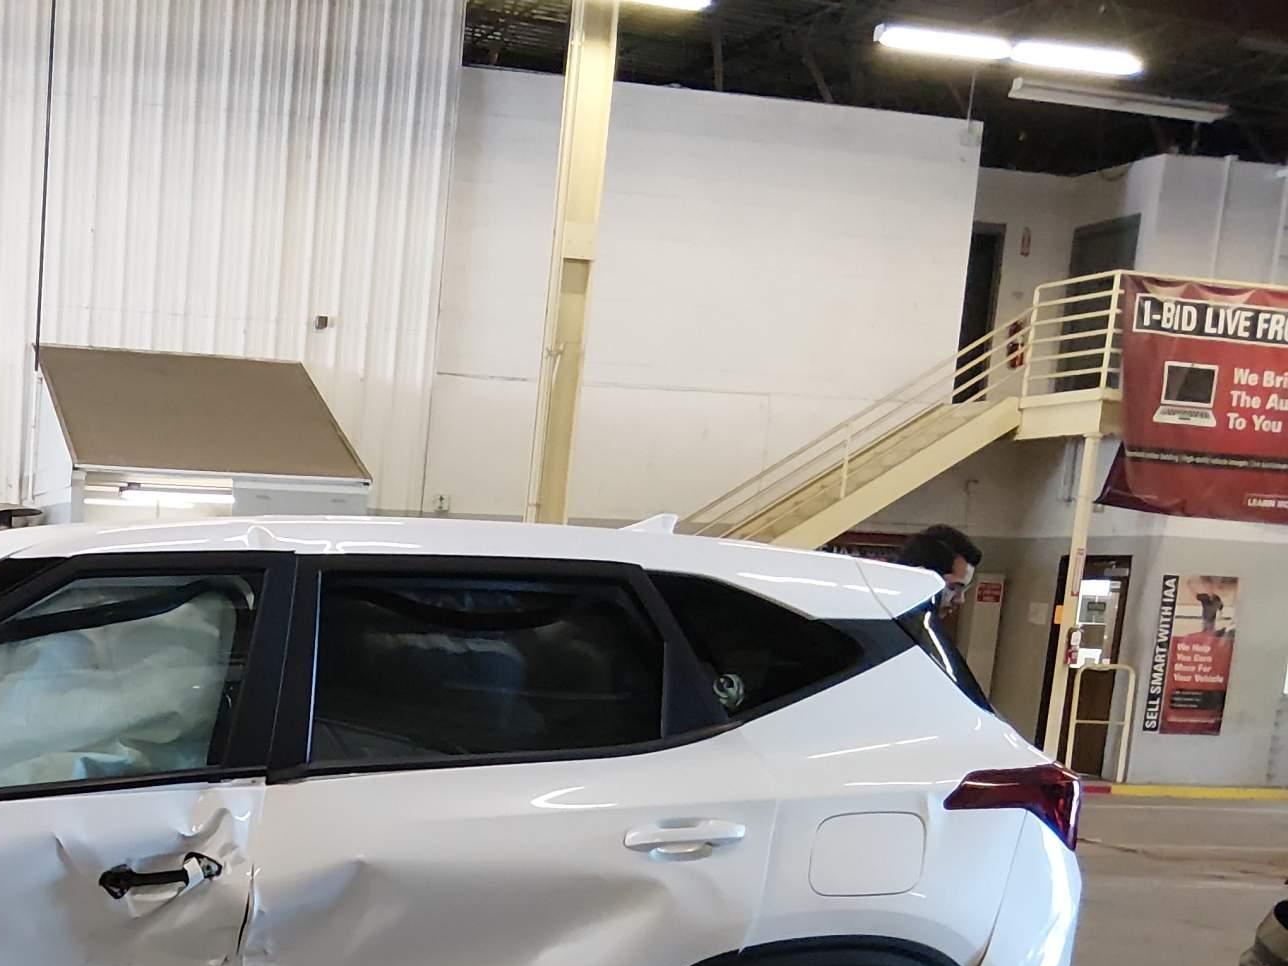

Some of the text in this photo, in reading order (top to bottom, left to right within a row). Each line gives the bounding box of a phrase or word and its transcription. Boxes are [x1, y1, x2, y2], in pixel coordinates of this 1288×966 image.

[1143, 300, 1197, 332] I-BID
[1204, 307, 1254, 337] LIVE
[1233, 367, 1259, 386] We
[1230, 390, 1262, 409] The
[1226, 412, 1283, 434] To You
[1145, 578, 1177, 729] SELL SMART WITH IAA
